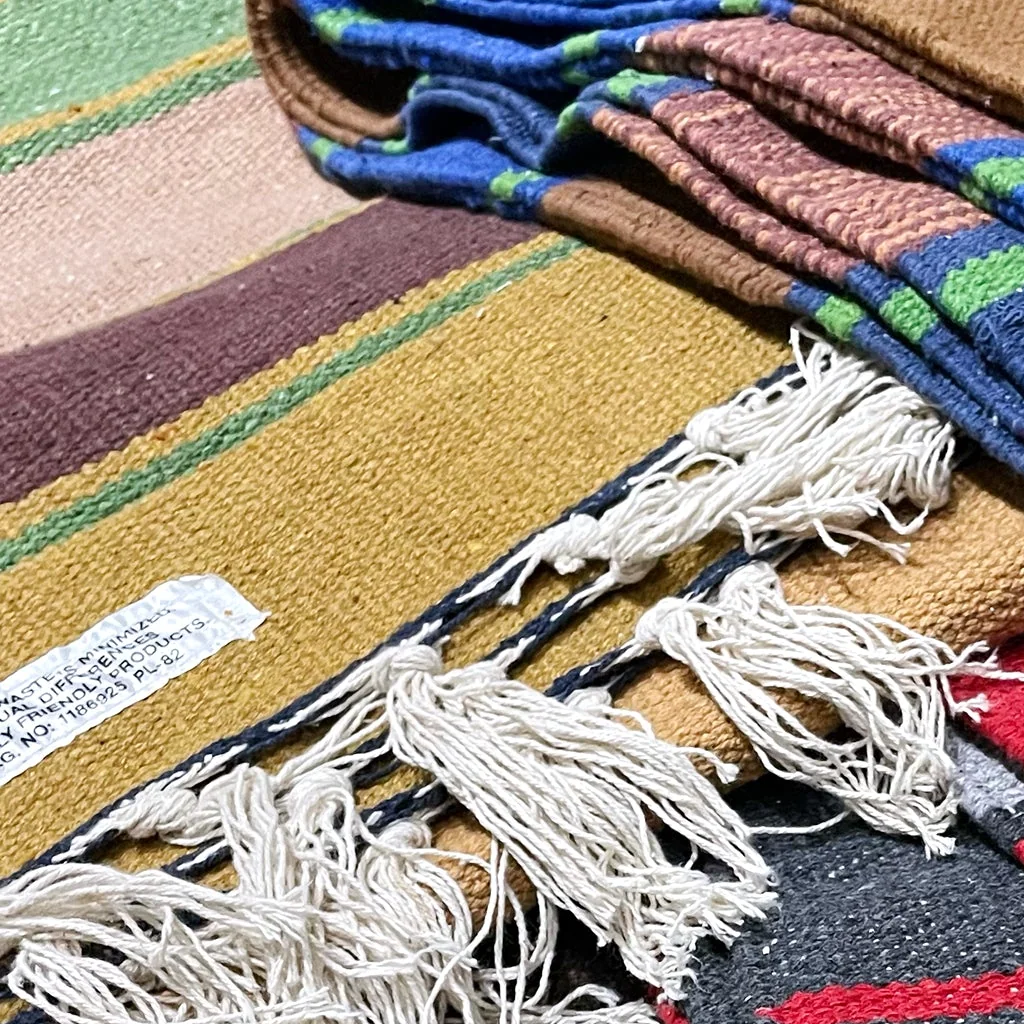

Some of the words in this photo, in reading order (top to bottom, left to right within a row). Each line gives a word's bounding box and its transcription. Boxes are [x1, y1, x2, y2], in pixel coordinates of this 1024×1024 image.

[16, 675, 102, 728] FRIENDLY
[20, 723, 55, 749] NO:
[58, 680, 128, 725] 1186925
[133, 648, 184, 683] PL-82
[38, 631, 160, 704] DIFFRENCES
